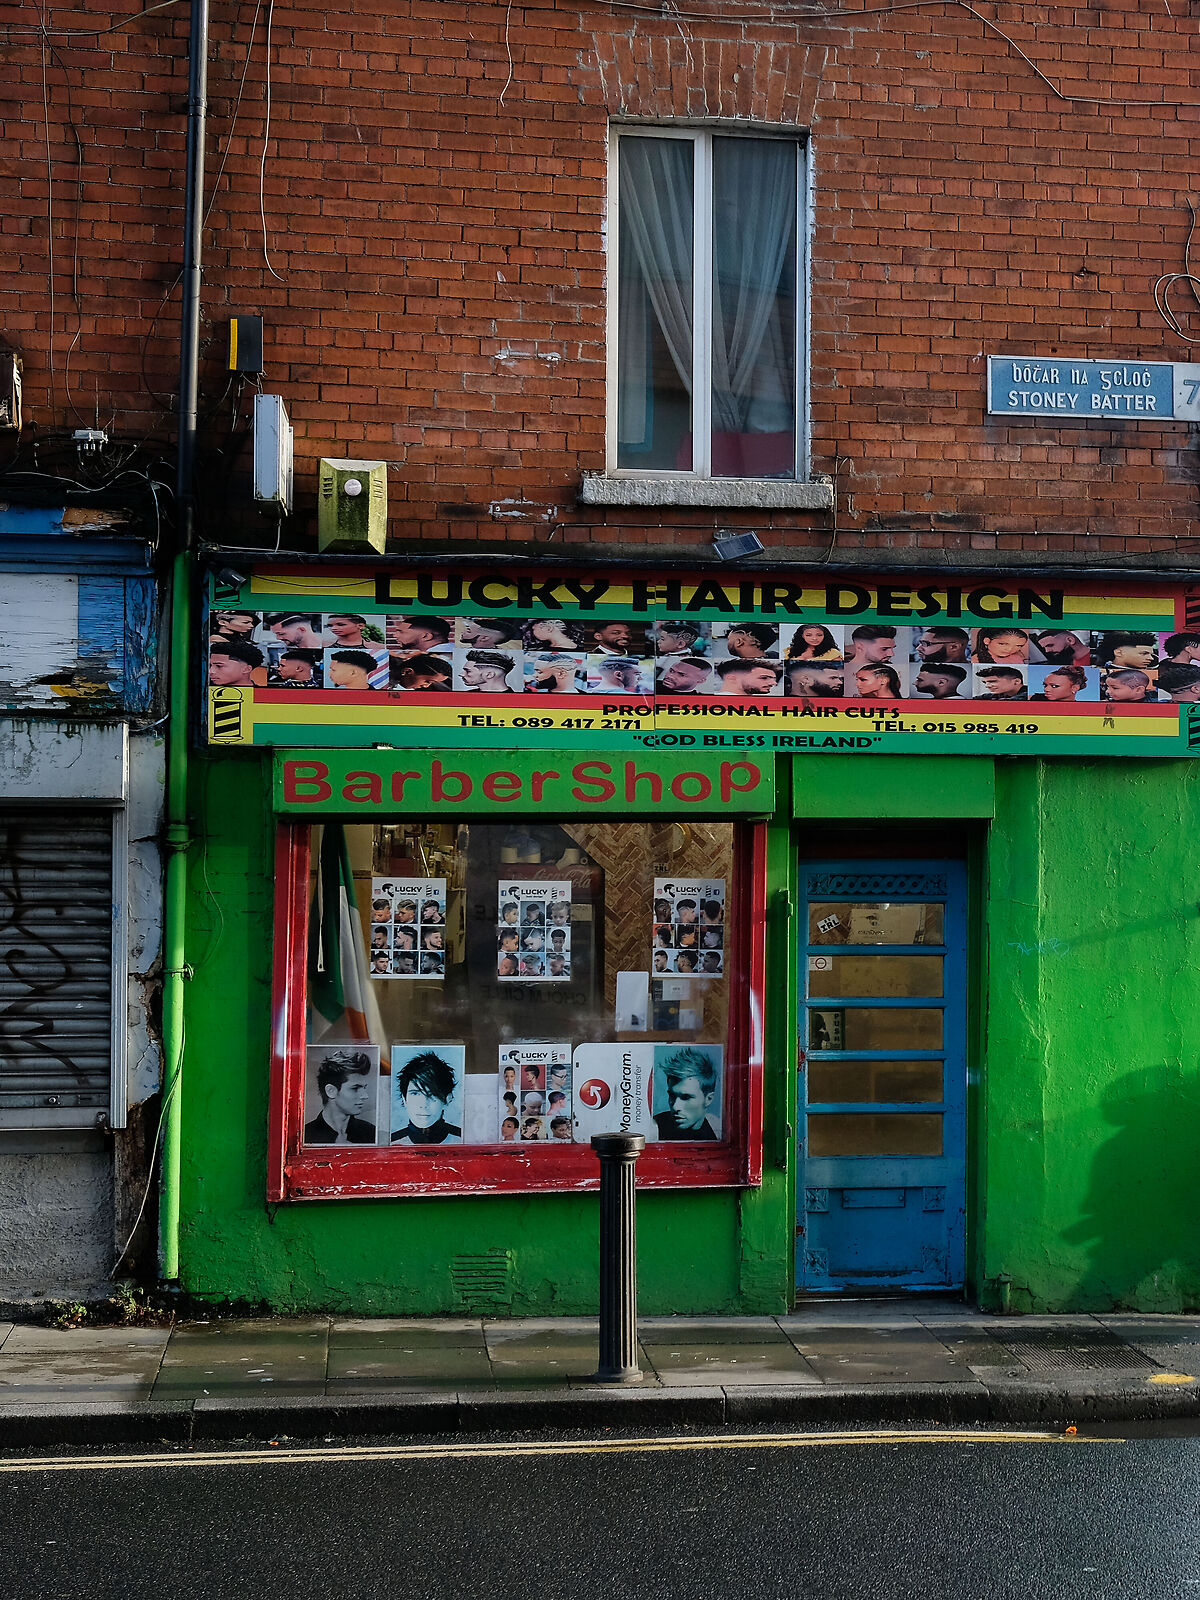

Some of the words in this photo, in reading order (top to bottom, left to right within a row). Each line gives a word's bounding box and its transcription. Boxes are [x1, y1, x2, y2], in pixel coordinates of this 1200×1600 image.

[1008, 390, 1079, 409] STONEY
[1091, 392, 1156, 411] BATTER
[1183, 379, 1200, 405] 7
[374, 571, 610, 611] LUCKY
[632, 578, 805, 614] HAIR
[824, 582, 1066, 621] DESIGN
[457, 714, 506, 728] TEL:
[512, 716, 554, 728] 089
[560, 716, 595, 729] 417
[601, 718, 642, 730] 2171
[602, 703, 776, 717] PROFESSIONAL
[781, 705, 839, 719] HAIR
[845, 706, 901, 720] CUTS
[872, 719, 918, 733] TEL:
[922, 721, 958, 733] 015
[962, 722, 1000, 734] 985
[1005, 722, 1039, 734] 419
[703, 734, 766, 747] BLESS
[772, 735, 883, 748] IRELAND"
[620, 1052, 634, 1132] MoneyGram
[634, 1065, 642, 1096] transfer
[635, 1097, 643, 1124] money
